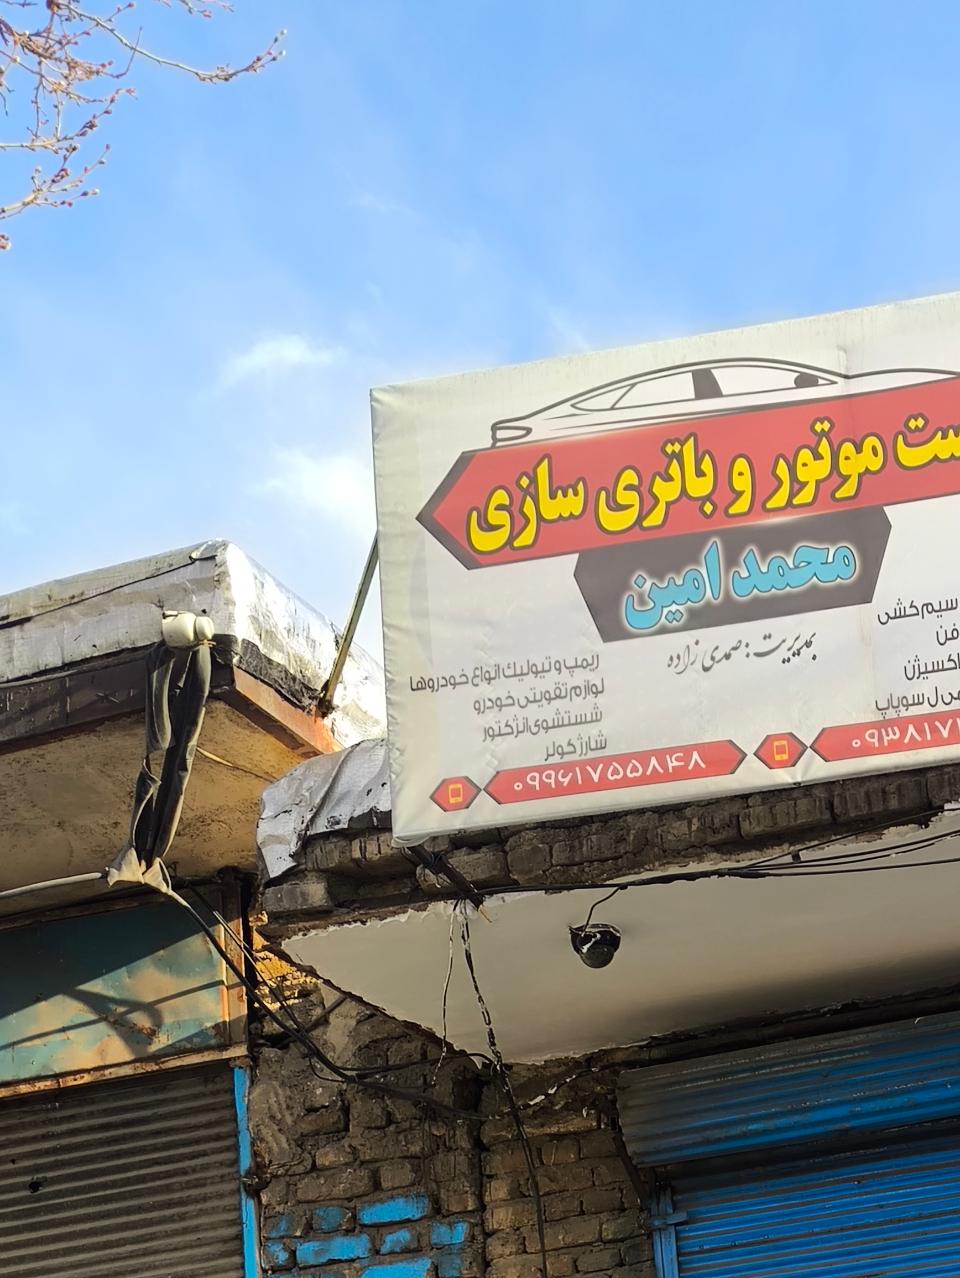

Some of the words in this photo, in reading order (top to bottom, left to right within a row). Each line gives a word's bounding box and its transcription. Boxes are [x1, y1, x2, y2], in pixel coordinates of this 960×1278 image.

[763, 418, 886, 511] موتور
[597, 434, 716, 533] باتری
[726, 455, 753, 516] و
[468, 455, 586, 553] سازی
[624, 540, 721, 630] امین
[731, 544, 857, 598] محمد
[877, 598, 920, 625] کشی
[920, 598, 959, 620] سیم
[936, 623, 960, 646] فن
[471, 664, 500, 687] انواع
[553, 658, 562, 675] و
[563, 653, 600, 677] ریمپ
[903, 653, 960, 681] اکسیژن
[409, 669, 469, 693] خودروها
[517, 681, 568, 709] تقویتی
[569, 677, 605, 702] لوازم
[472, 691, 516, 715] خودرو
[875, 692, 925, 720] سوپاپ
[482, 714, 529, 743] انژکتور
[529, 702, 603, 735] شستشوی
[544, 738, 577, 762] کولر
[575, 730, 607, 757] شارژ
[513, 750, 706, 791] ۰۹۹۶۱۷۵۵۸۴۸
